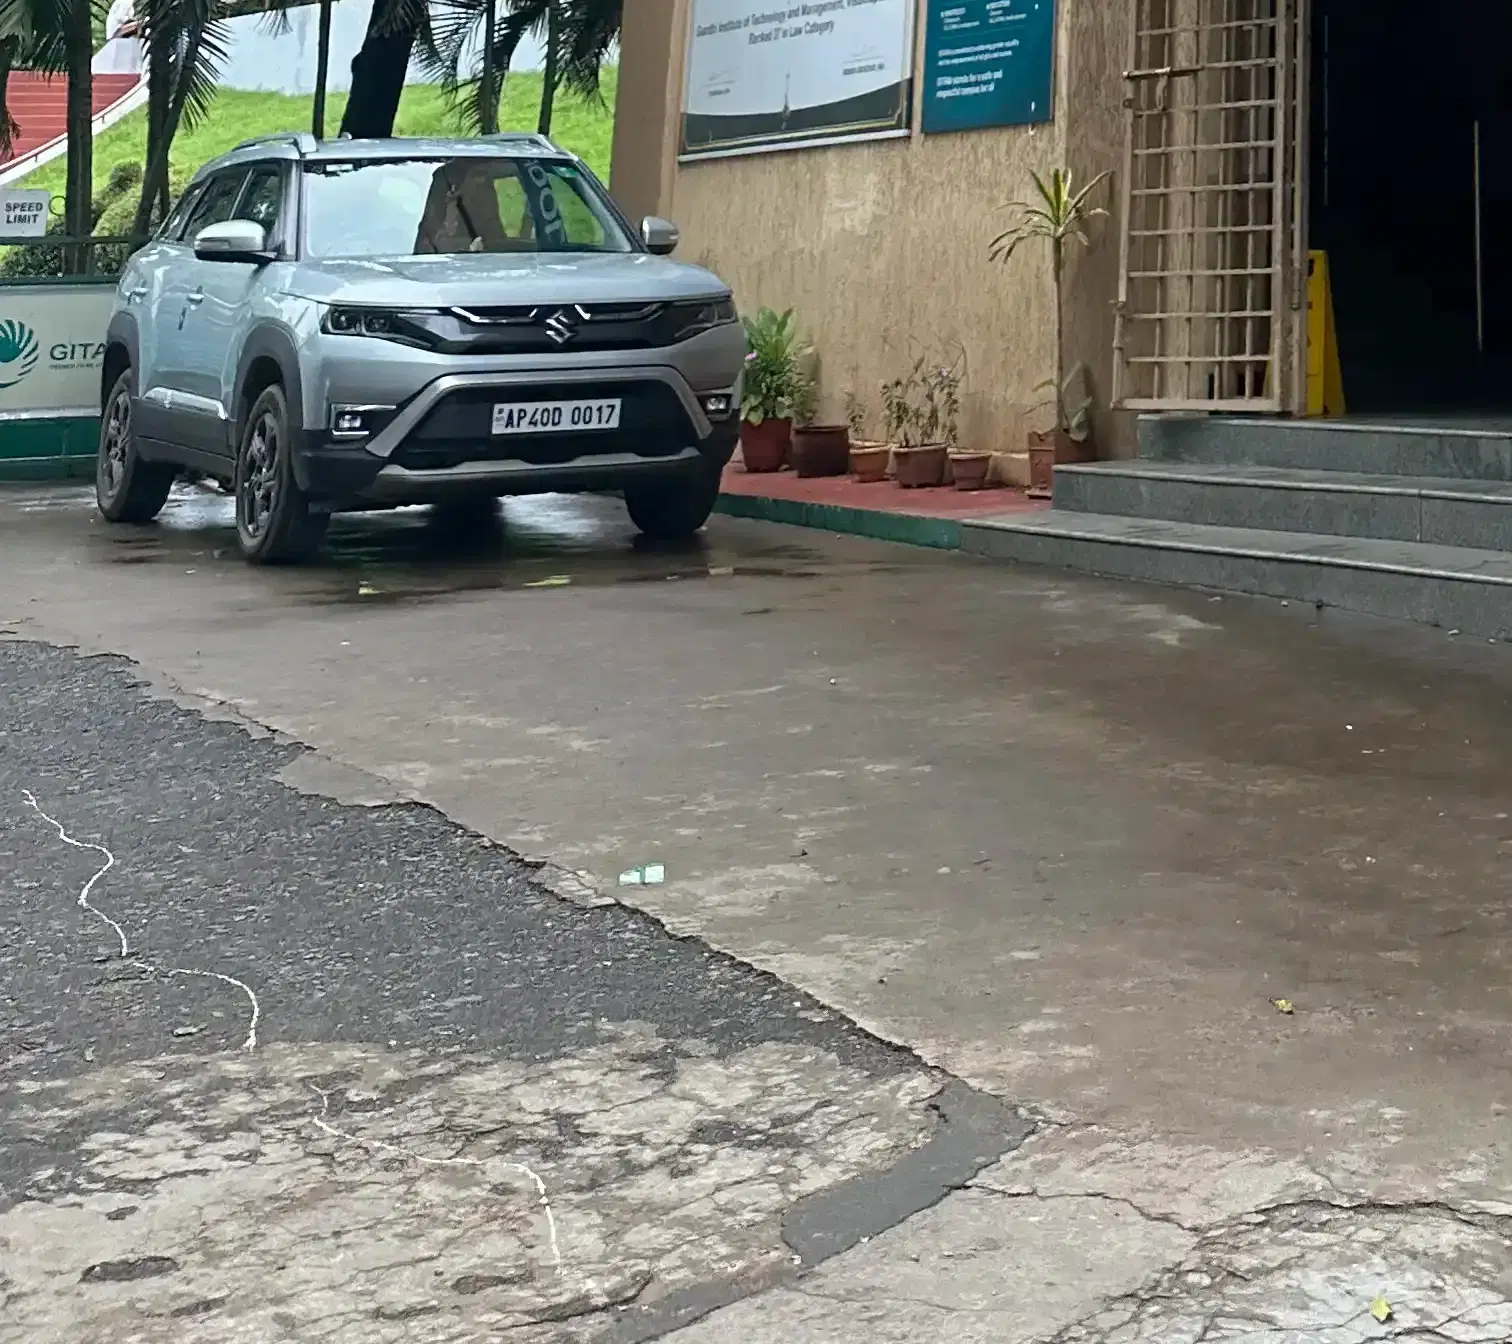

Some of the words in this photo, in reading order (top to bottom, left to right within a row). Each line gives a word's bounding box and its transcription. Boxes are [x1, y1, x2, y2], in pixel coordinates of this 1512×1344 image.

[5, 202, 43, 213] SPEED
[6, 214, 39, 225] LIMIT
[49, 342, 106, 361] GITA
[505, 407, 562, 428] AP40D
[571, 404, 616, 426] 0017
